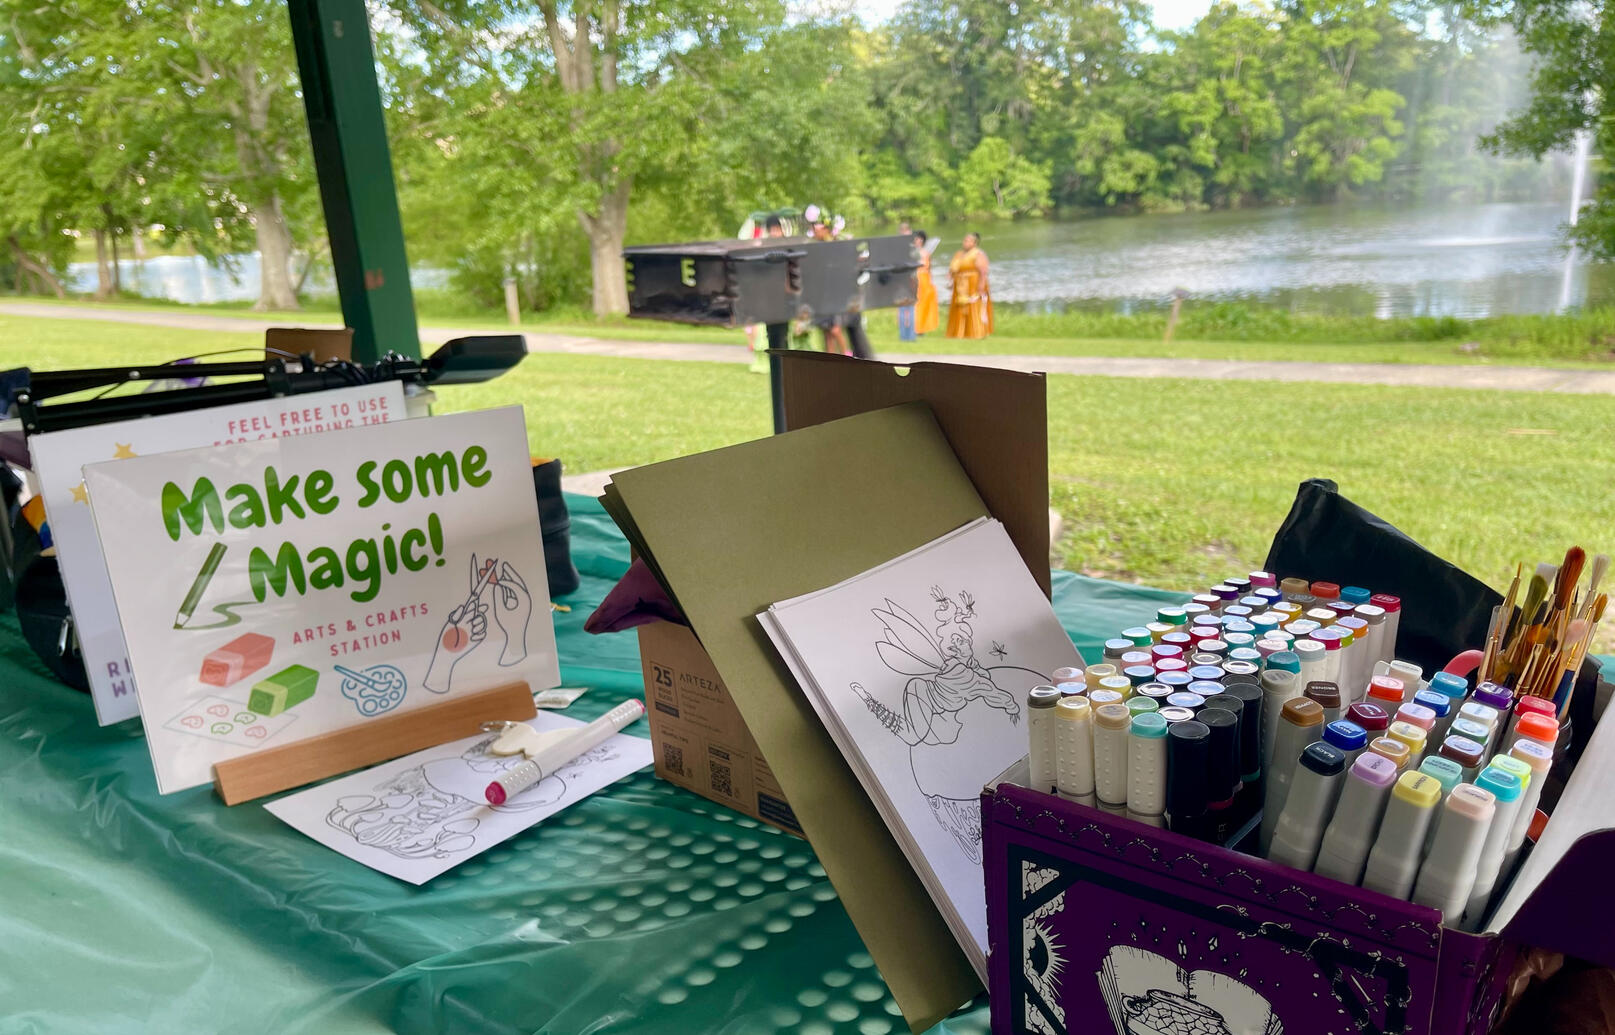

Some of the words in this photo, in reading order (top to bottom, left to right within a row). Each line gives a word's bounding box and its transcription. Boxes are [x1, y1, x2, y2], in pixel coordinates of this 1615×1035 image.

[228, 416, 272, 435] FEEL
[280, 407, 323, 427] FREE
[331, 402, 349, 418] TO
[358, 396, 388, 413] USE
[362, 413, 389, 427] THE
[161, 465, 340, 542] Make
[356, 445, 492, 508] some
[248, 512, 446, 604] Magic!
[292, 623, 337, 645] ARTS
[346, 619, 357, 632] &
[365, 602, 429, 628] CRAFTS
[330, 629, 402, 657] STATION
[653, 665, 673, 688] 25
[679, 672, 722, 695] ARTEZA
